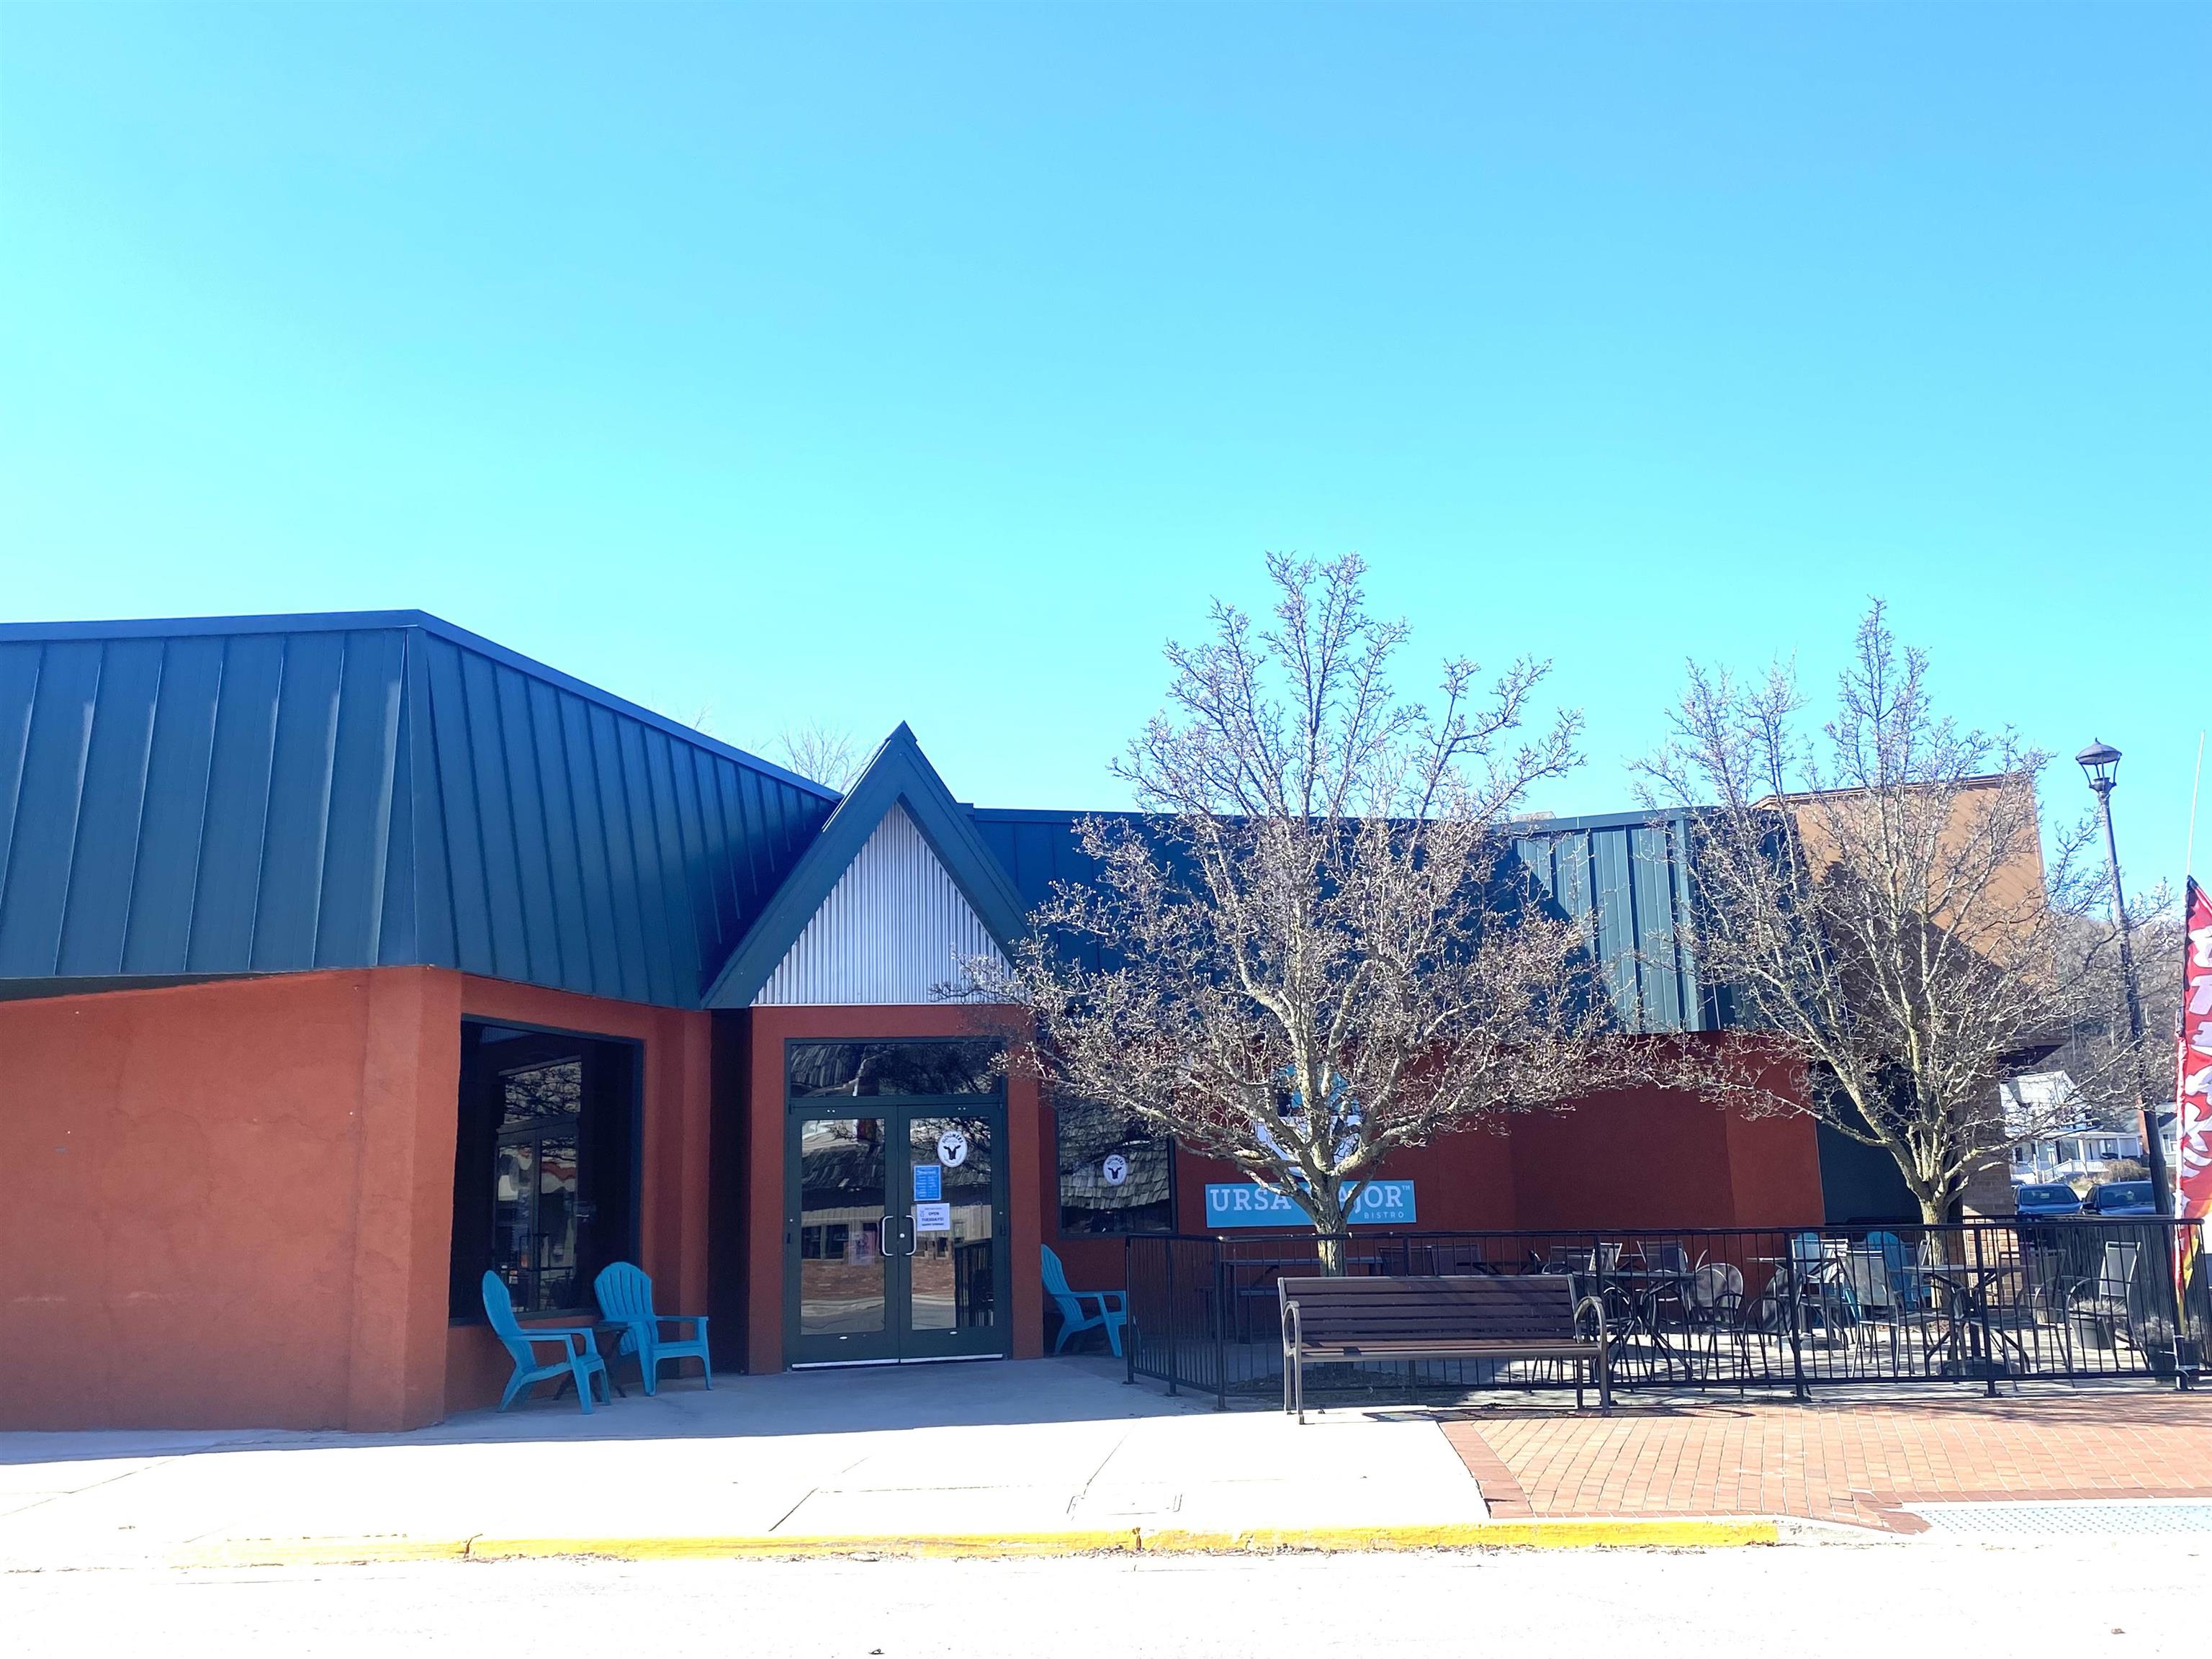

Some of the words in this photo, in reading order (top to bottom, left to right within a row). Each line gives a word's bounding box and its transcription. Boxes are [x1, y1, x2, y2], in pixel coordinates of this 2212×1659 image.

[1210, 1187, 1292, 1211] URSA
[1305, 1184, 1403, 1213] AJOR
[1364, 1211, 1405, 1220] BISTRO
